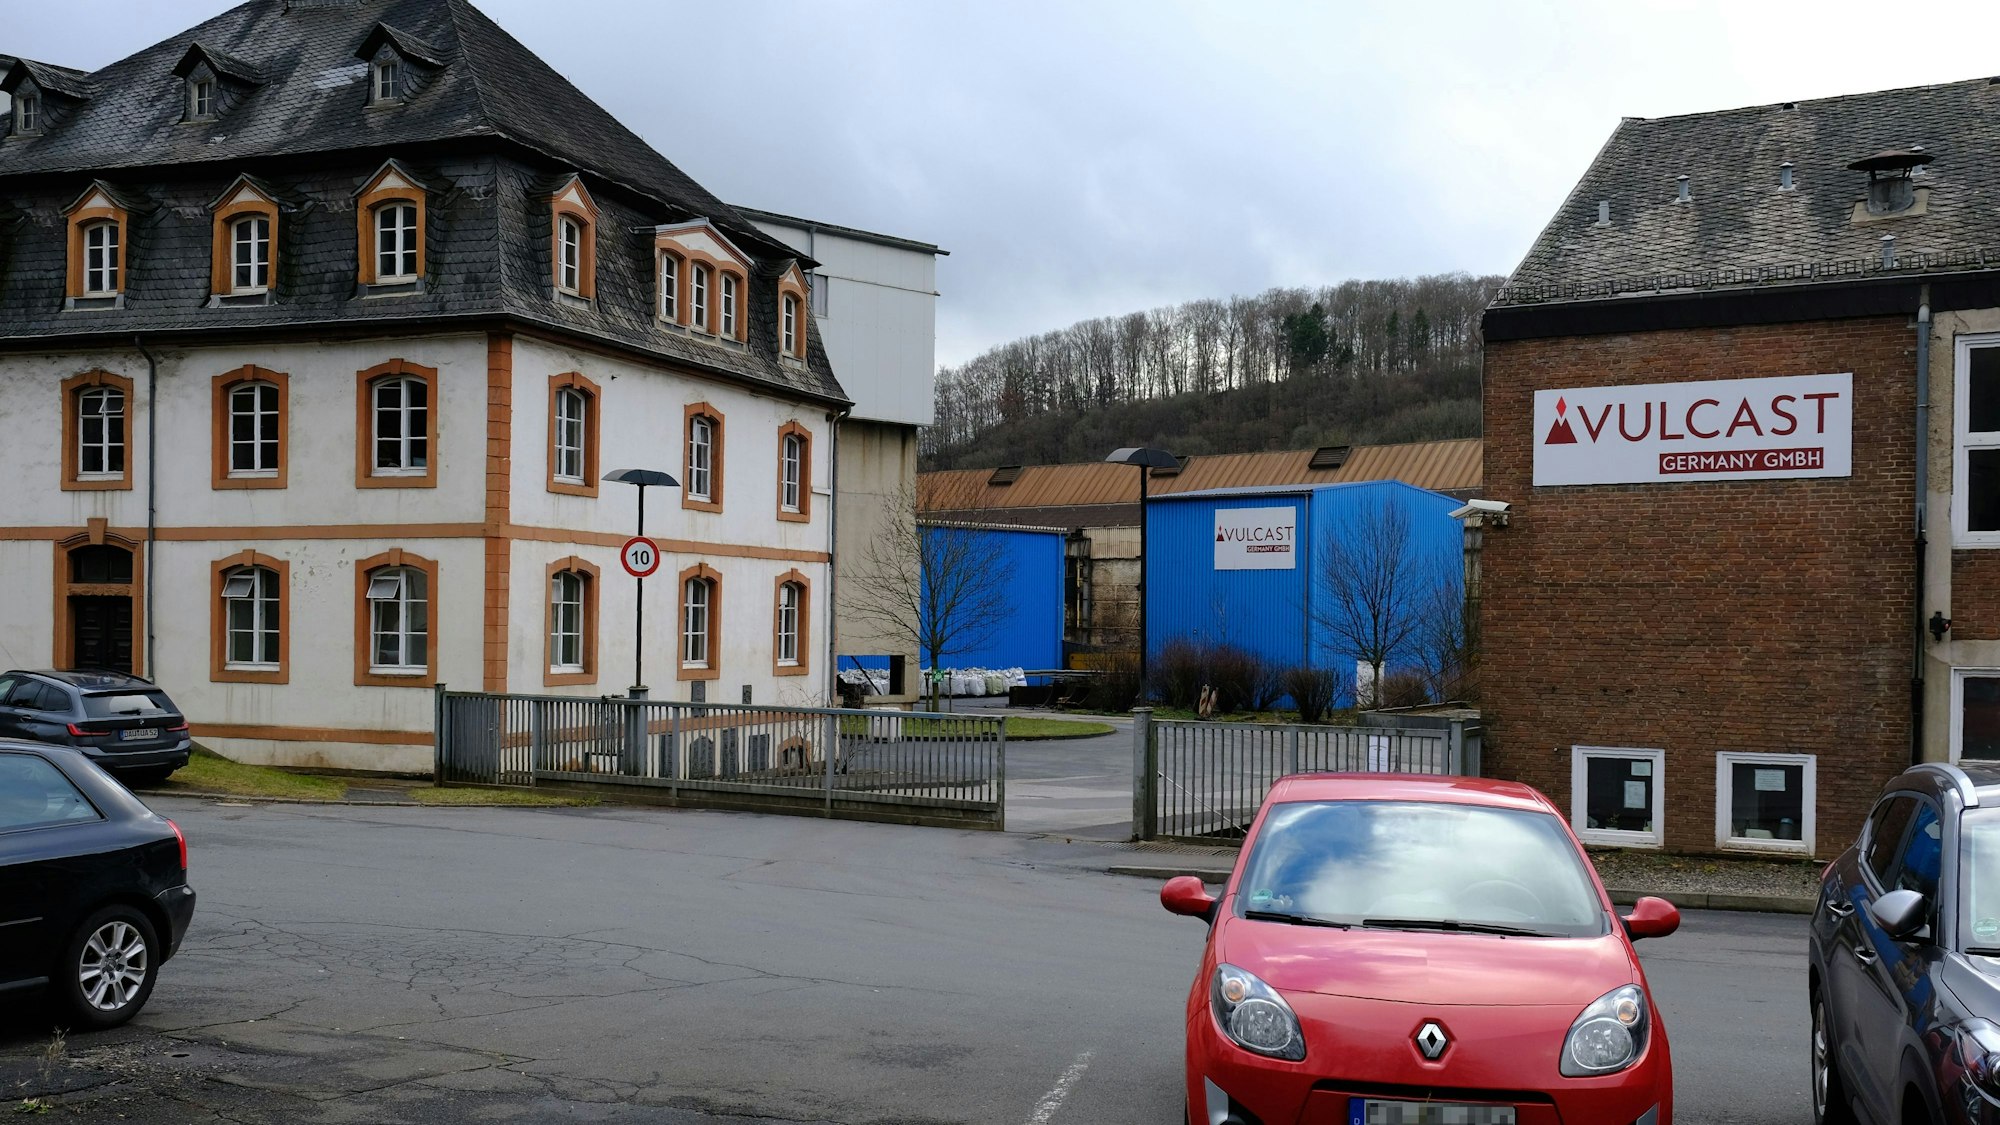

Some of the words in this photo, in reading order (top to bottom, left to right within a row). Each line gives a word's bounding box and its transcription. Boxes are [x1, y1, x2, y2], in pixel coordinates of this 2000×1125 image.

[1577, 392, 1840, 444] VULCAST
[1661, 453, 1758, 471] GERMANY
[1763, 450, 1821, 468] GMBH
[1224, 526, 1294, 542] VULCAST
[631, 550, 650, 565] 10
[1353, 1117, 1361, 1125] D
